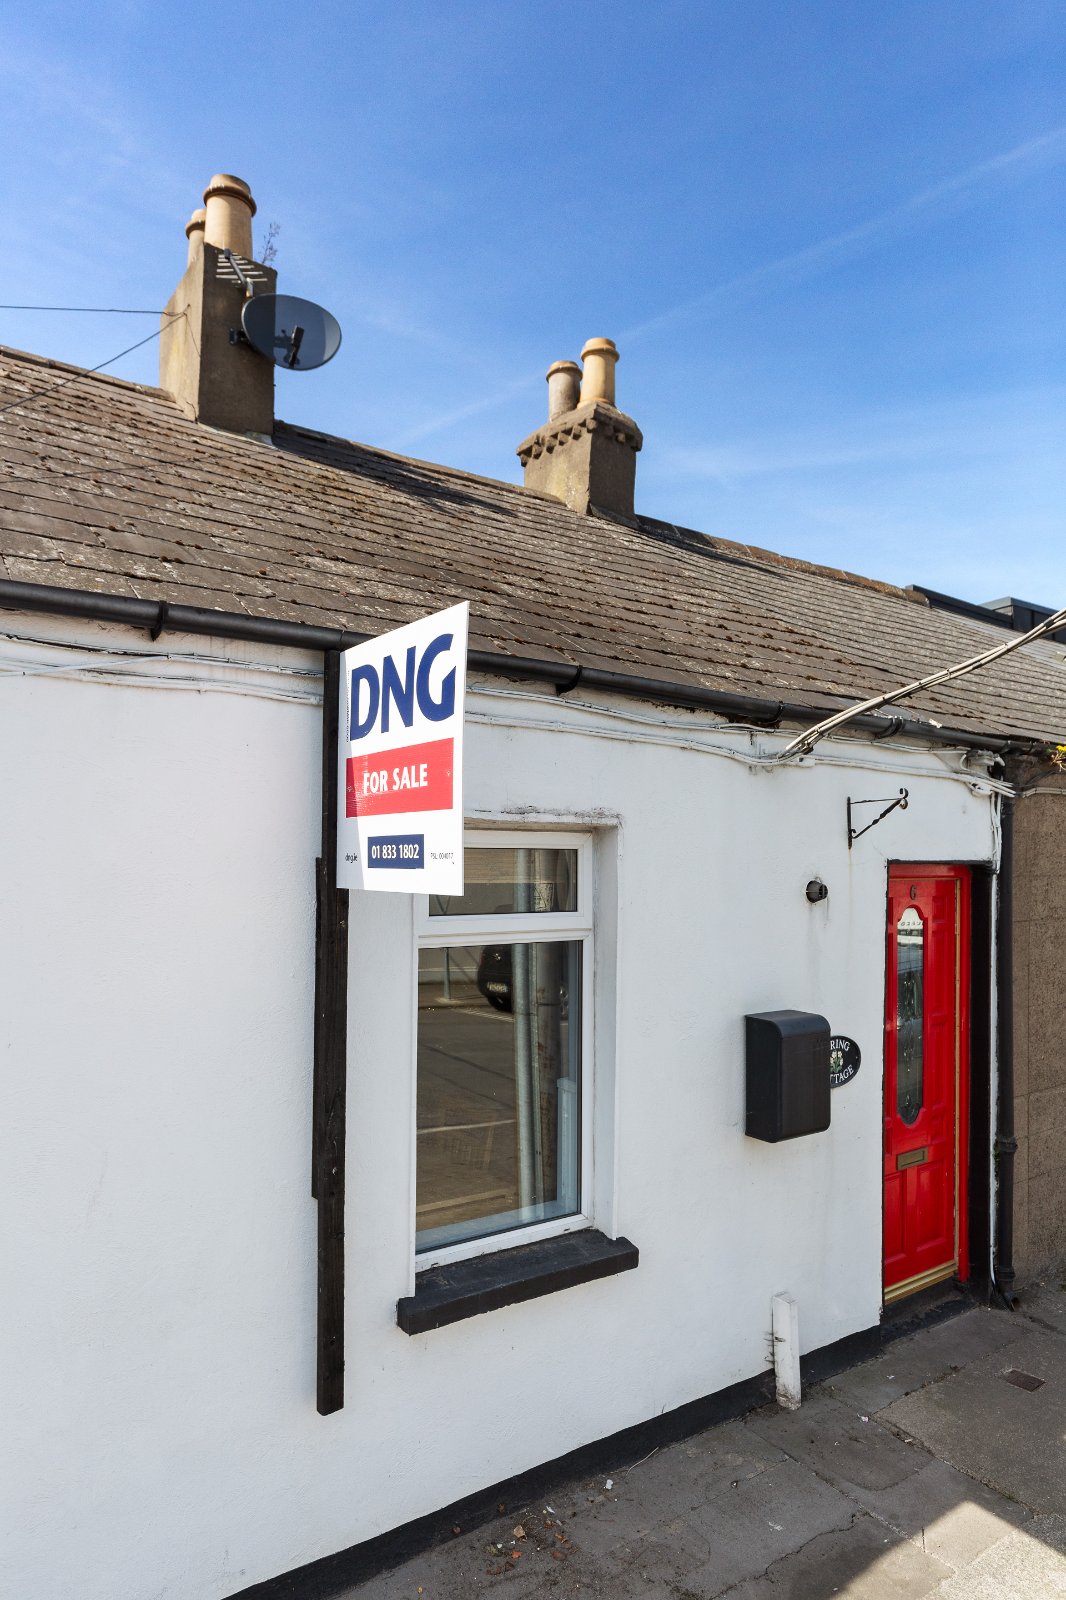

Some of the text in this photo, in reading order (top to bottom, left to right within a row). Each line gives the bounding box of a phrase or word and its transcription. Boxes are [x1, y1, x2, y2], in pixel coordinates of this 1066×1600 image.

[350, 633, 456, 741] DNG
[363, 763, 428, 796] FOR SALE
[371, 844, 419, 859] 01 833 1802
[910, 884, 917, 901] 6
[830, 1039, 850, 1051] RING
[830, 1064, 854, 1084] TTAGE
